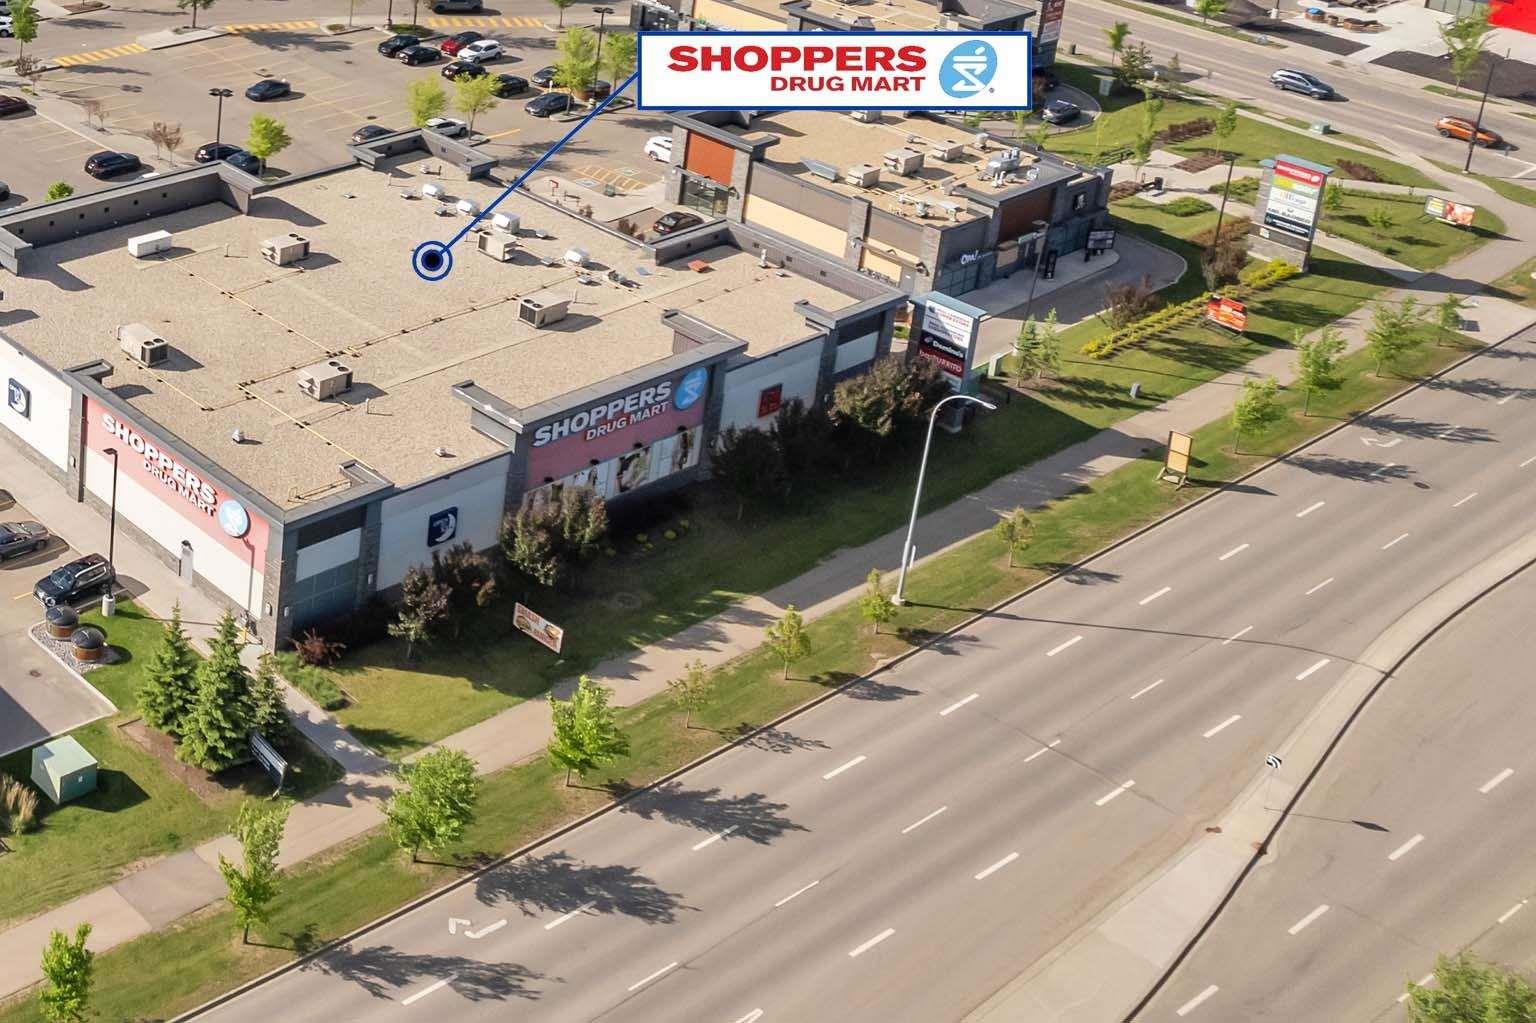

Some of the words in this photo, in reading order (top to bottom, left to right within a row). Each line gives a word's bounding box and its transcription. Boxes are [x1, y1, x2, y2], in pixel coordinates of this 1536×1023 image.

[532, 381, 672, 447] SHOPPERS
[586, 418, 627, 441] DRUG
[629, 402, 668, 425] MART
[102, 412, 217, 505] SHOPPERS
[144, 459, 178, 491] DRUG
[178, 486, 215, 517] MART
